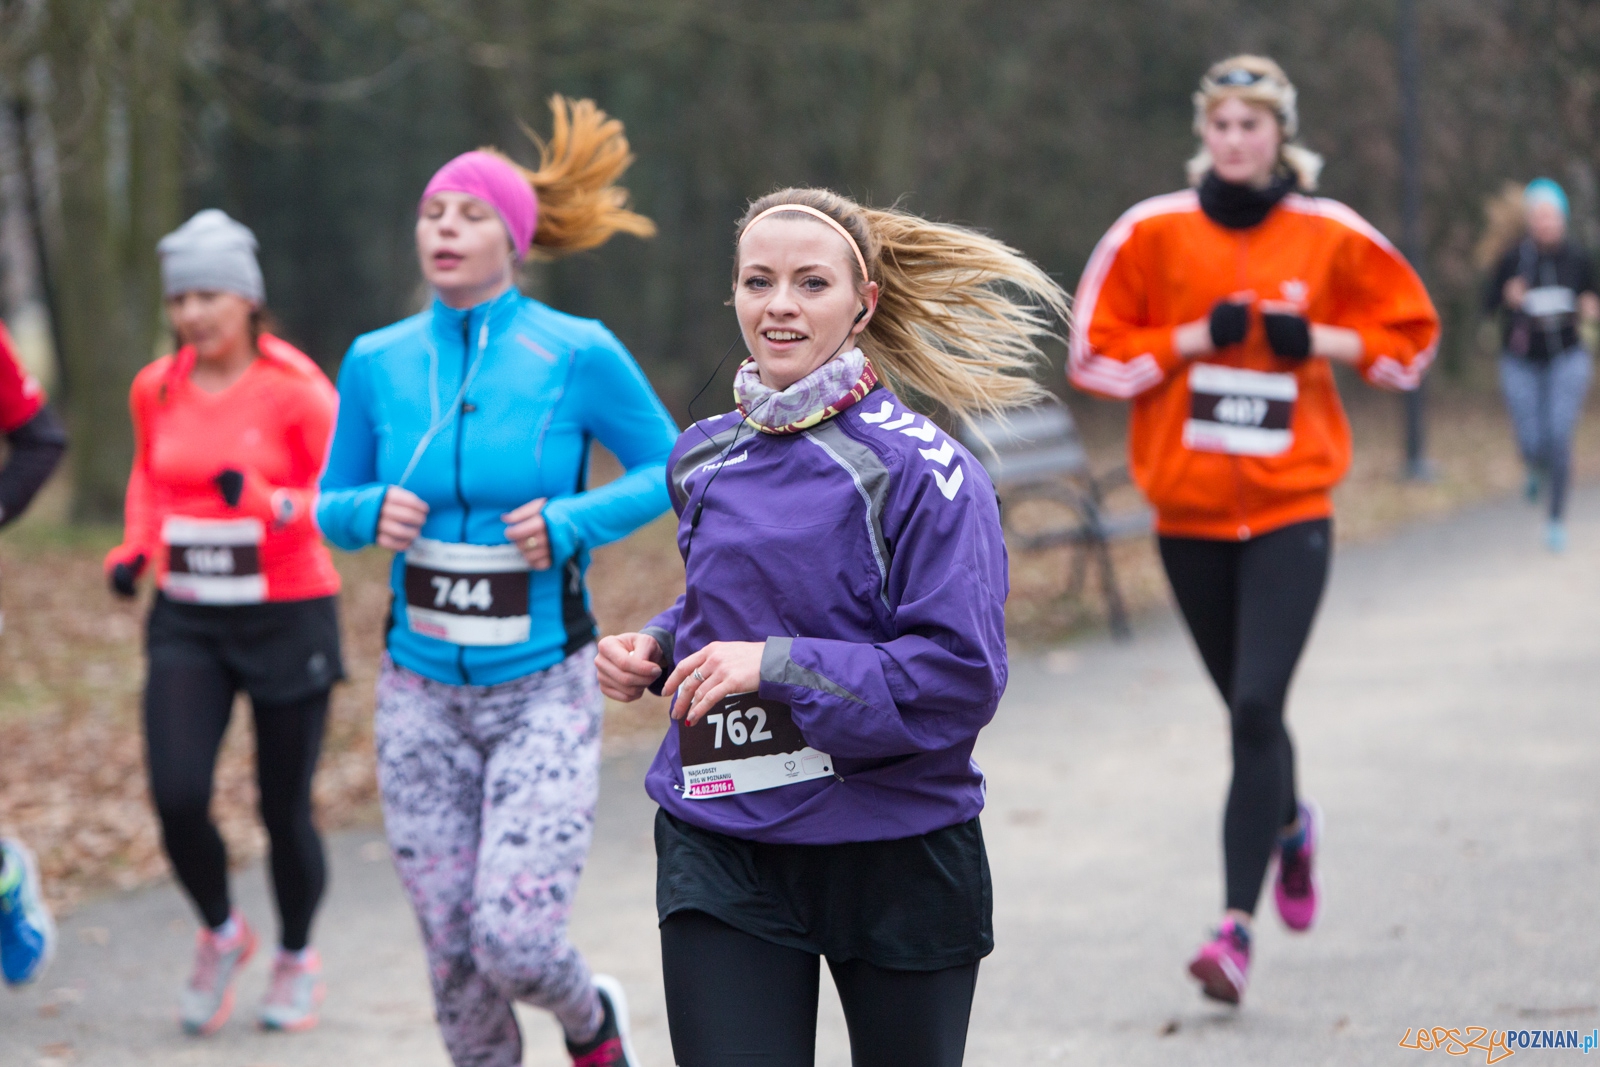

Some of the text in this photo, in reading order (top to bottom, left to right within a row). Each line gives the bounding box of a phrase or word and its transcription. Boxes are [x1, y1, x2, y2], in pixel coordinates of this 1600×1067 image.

[431, 576, 494, 611] 744
[707, 706, 773, 749] 762
[690, 777, 701, 785] BIEG
[706, 772, 732, 782] POZNANIU
[691, 782, 734, 796] 14.02.2016 r.
